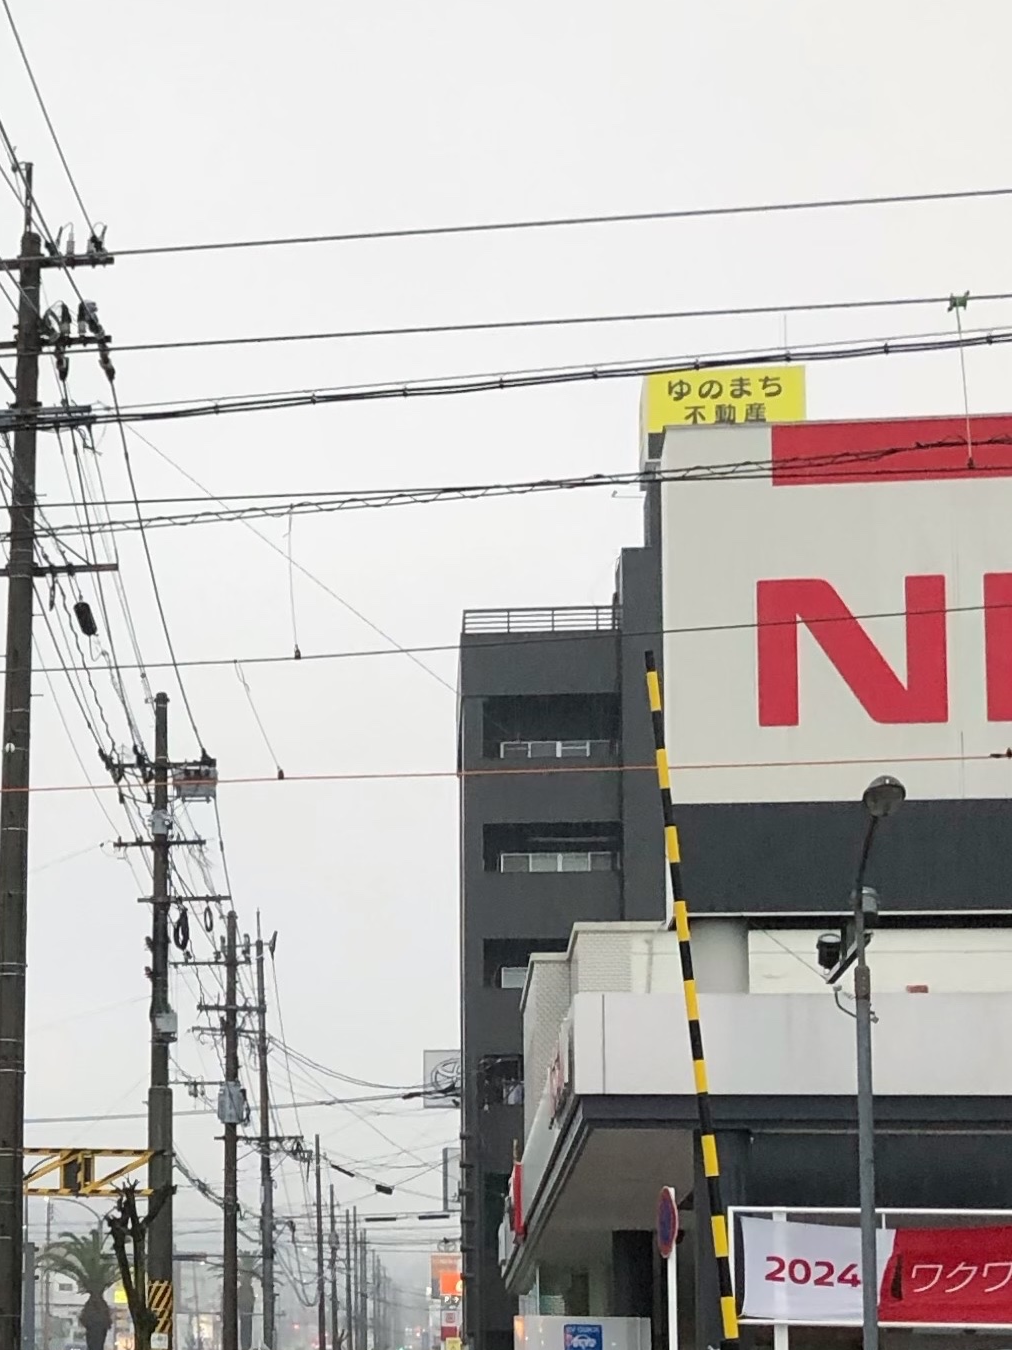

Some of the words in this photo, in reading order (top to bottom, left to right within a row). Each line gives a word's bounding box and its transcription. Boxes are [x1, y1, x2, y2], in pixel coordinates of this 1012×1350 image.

[667, 375, 783, 403] ゆのまち
[684, 402, 767, 424] 不動産
[764, 1256, 861, 1288] 2024
[911, 1261, 1012, 1293] ワクワ
